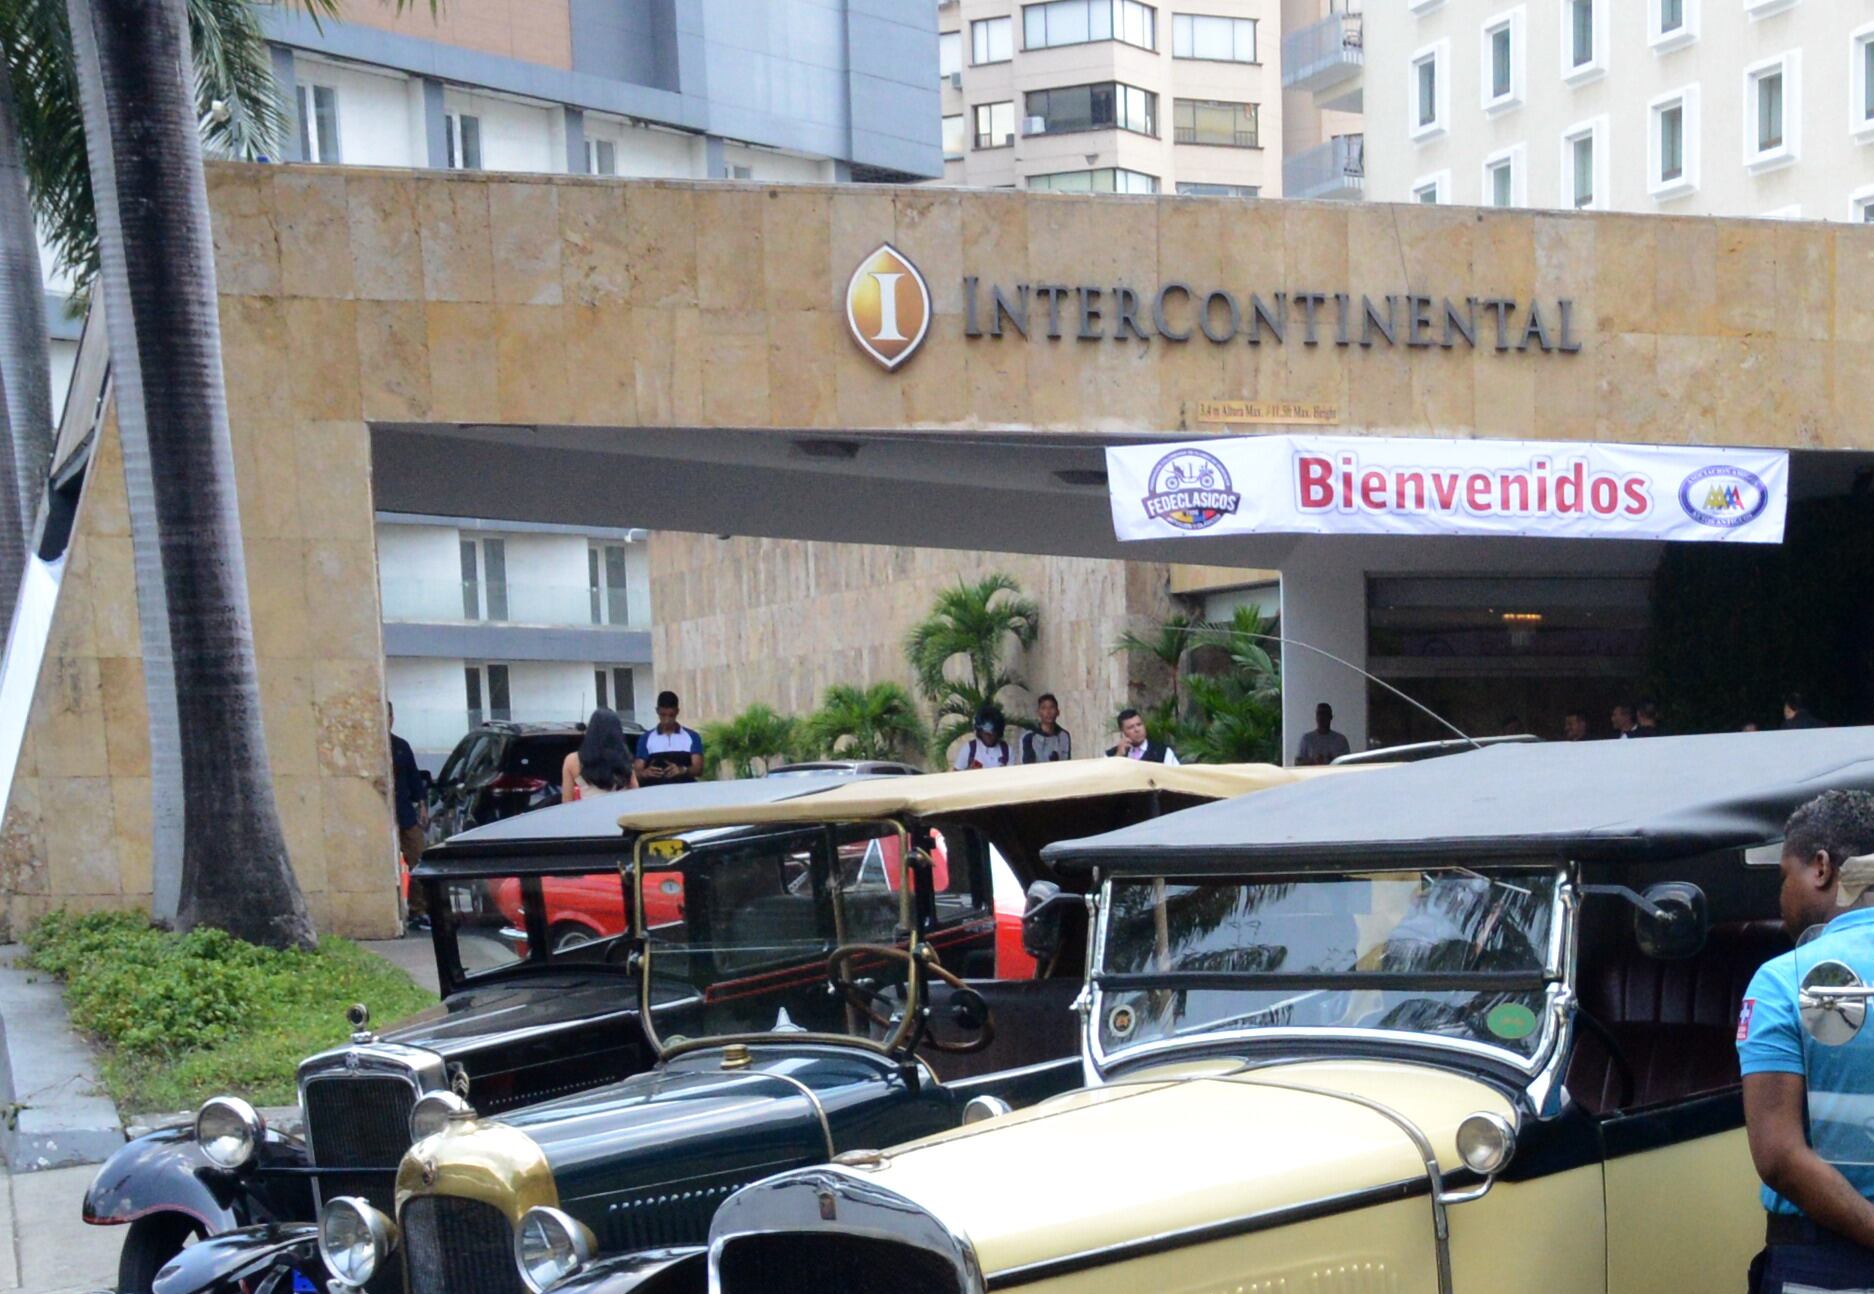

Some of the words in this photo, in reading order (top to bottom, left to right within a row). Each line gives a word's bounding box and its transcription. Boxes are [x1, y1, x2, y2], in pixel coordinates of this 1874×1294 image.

[963, 275, 1582, 354] INTERCONTINENTAL
[1147, 491, 1238, 516] FEDECLASICOS
[1298, 456, 1649, 516] Bienvenidos
